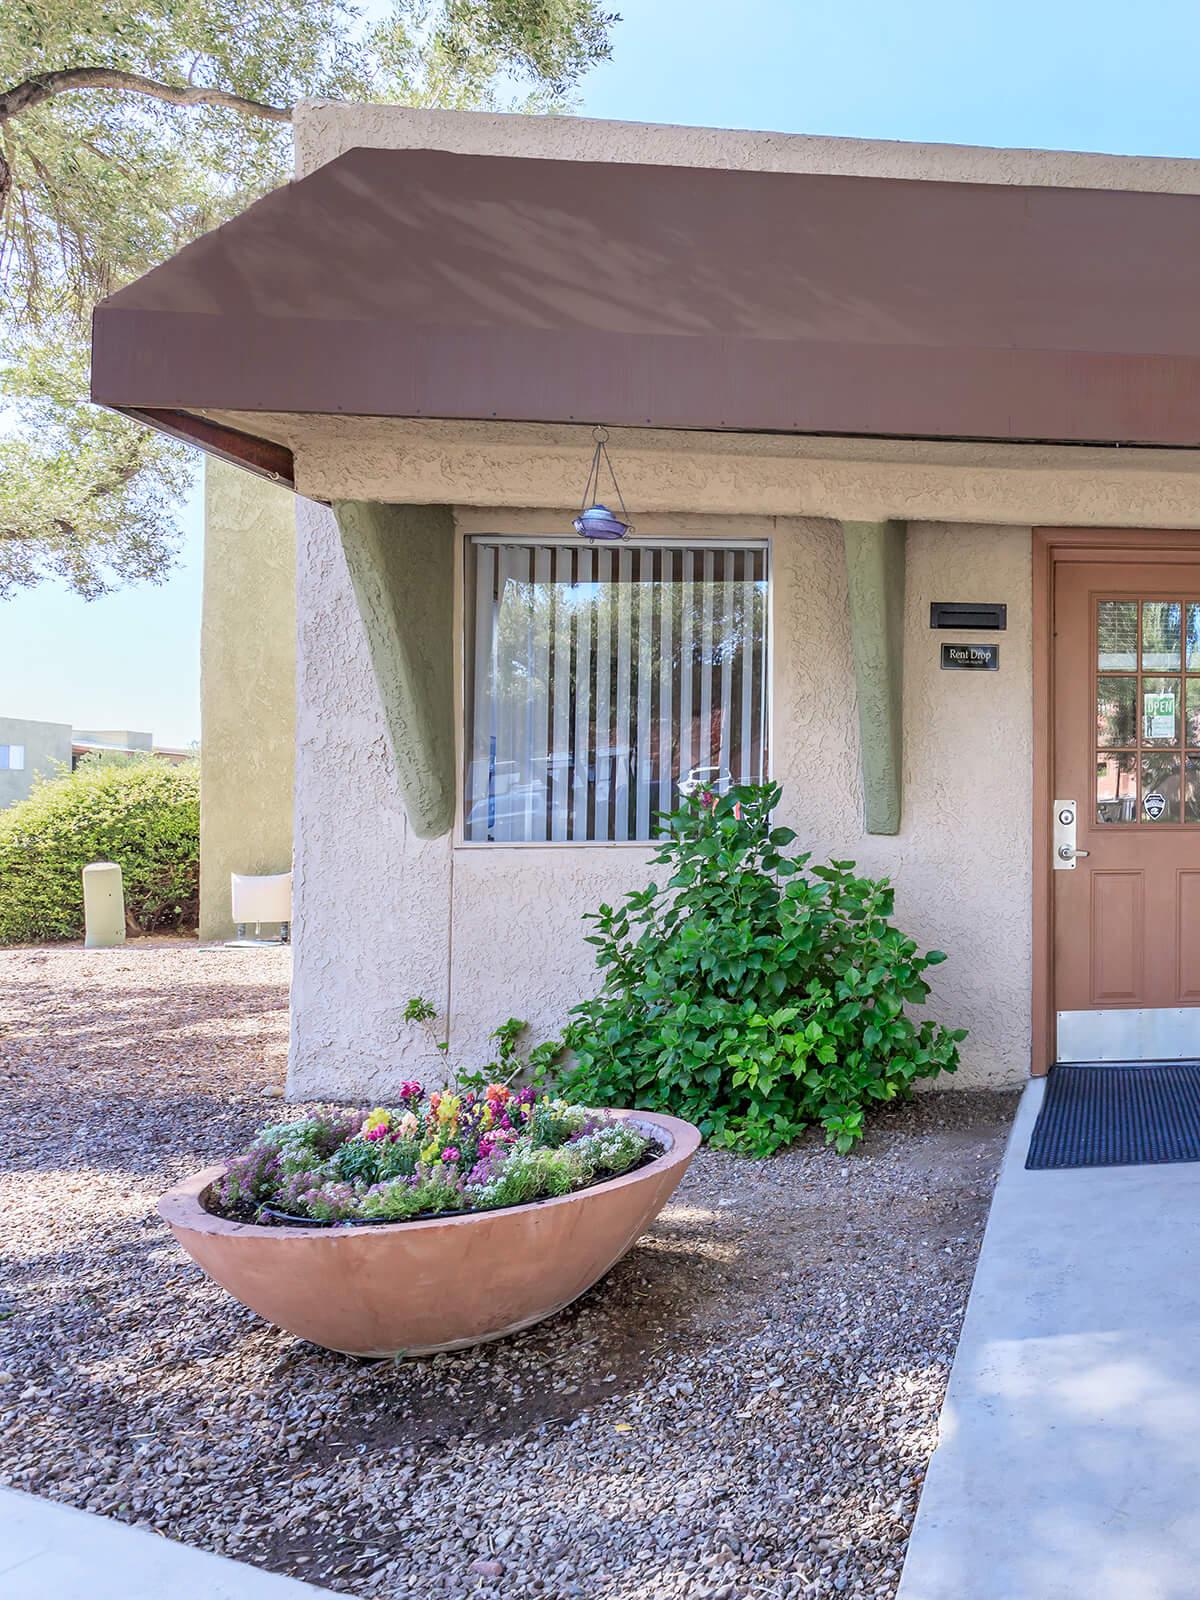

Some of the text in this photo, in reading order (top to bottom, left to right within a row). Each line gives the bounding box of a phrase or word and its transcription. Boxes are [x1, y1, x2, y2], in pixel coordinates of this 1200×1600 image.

[950, 649, 968, 659] Rent
[970, 649, 991, 662] Drop
[1147, 701, 1173, 713] OPEN
